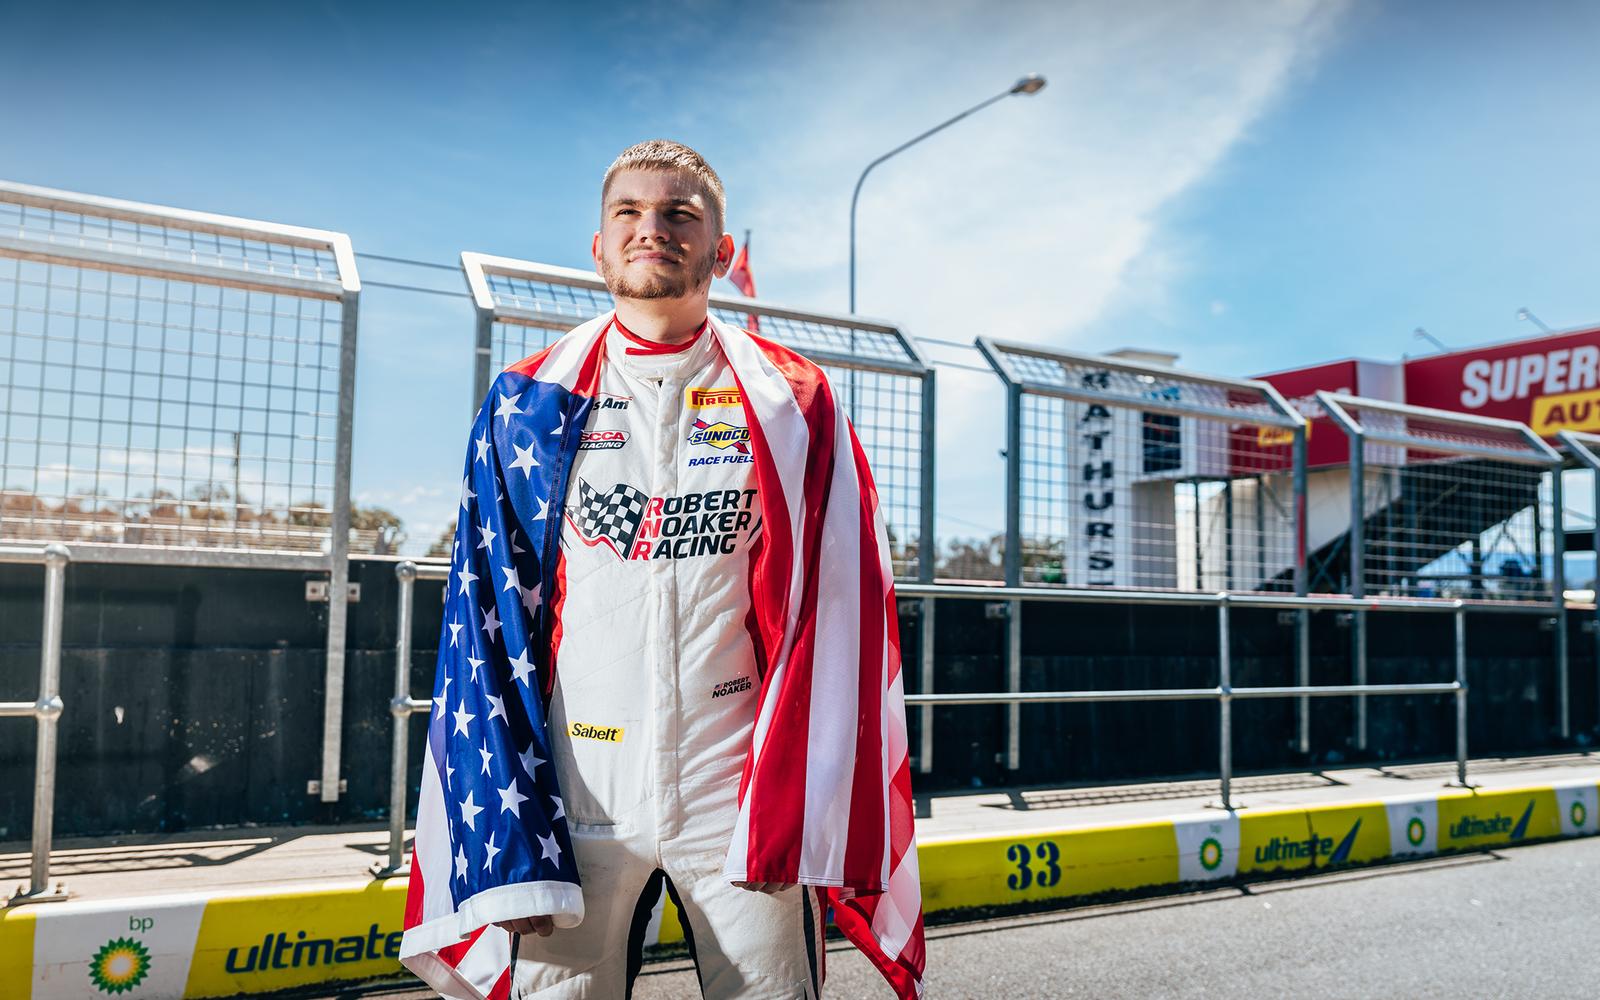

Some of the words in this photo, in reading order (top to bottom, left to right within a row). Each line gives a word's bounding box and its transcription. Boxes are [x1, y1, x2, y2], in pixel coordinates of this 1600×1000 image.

[1460, 345, 1600, 409] SUPER
[579, 441, 623, 450] RACING
[581, 431, 625, 441] SCCA
[693, 430, 750, 443] SUNOCO
[688, 456, 721, 467] RACE
[722, 455, 755, 464] FUELS
[645, 489, 758, 518] ROBERT
[639, 511, 752, 538] NOAKER
[631, 533, 738, 561] RACING
[711, 681, 752, 699] NOAKER
[723, 675, 750, 688] ROBERT
[571, 722, 618, 742] Sabelt
[1450, 814, 1513, 838] ultimate
[1254, 833, 1334, 863] ultimate
[1007, 841, 1062, 891] 33
[129, 915, 154, 934] bp
[225, 923, 404, 974] ultimate
